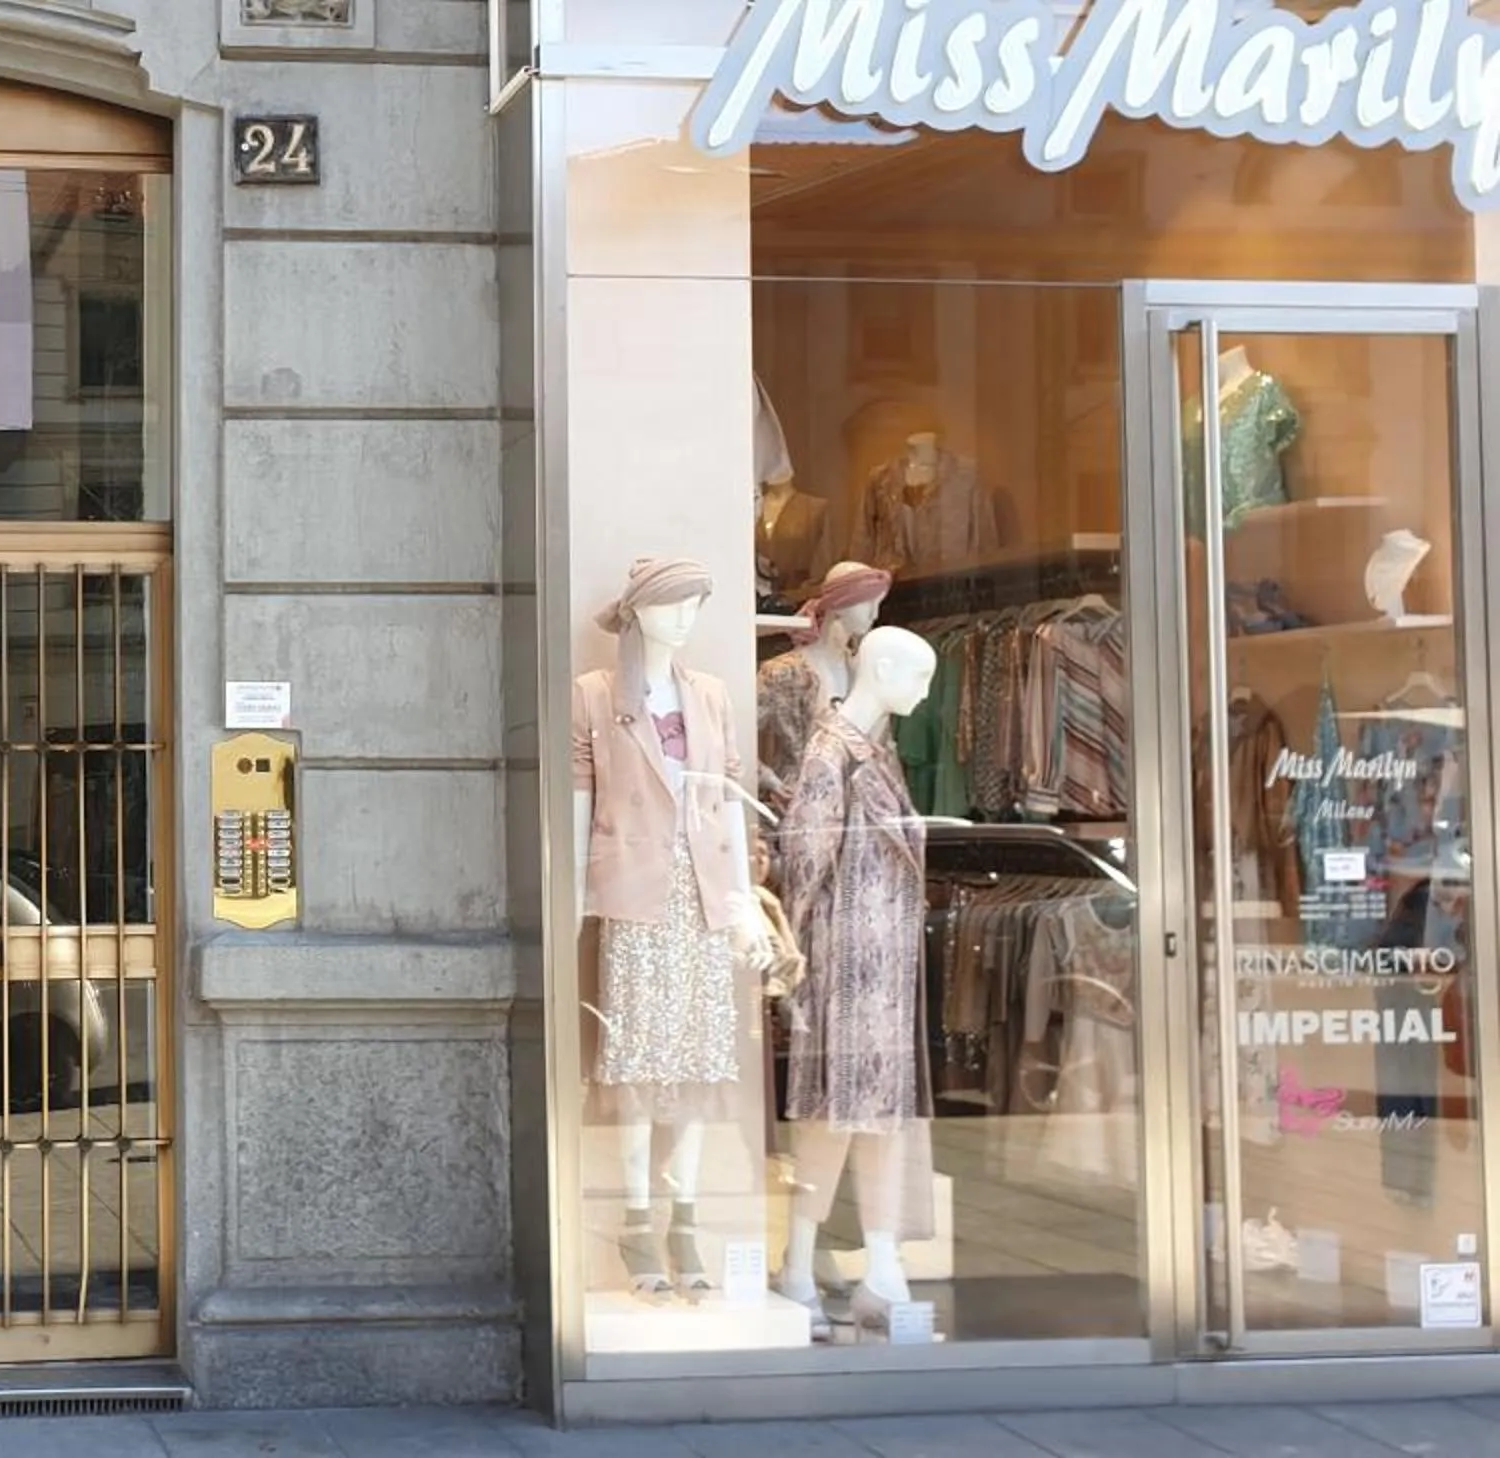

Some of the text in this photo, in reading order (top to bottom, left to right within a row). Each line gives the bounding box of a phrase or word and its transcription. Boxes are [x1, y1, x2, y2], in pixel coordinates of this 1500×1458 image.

[708, 0, 1040, 148] Miss
[244, 124, 311, 173] 24
[1265, 746, 1418, 791] Miss Marilyn
[1313, 799, 1375, 825] Milano
[1235, 947, 1455, 976] RINASCIMENTO
[1237, 1008, 1457, 1046] IMPERIAL
